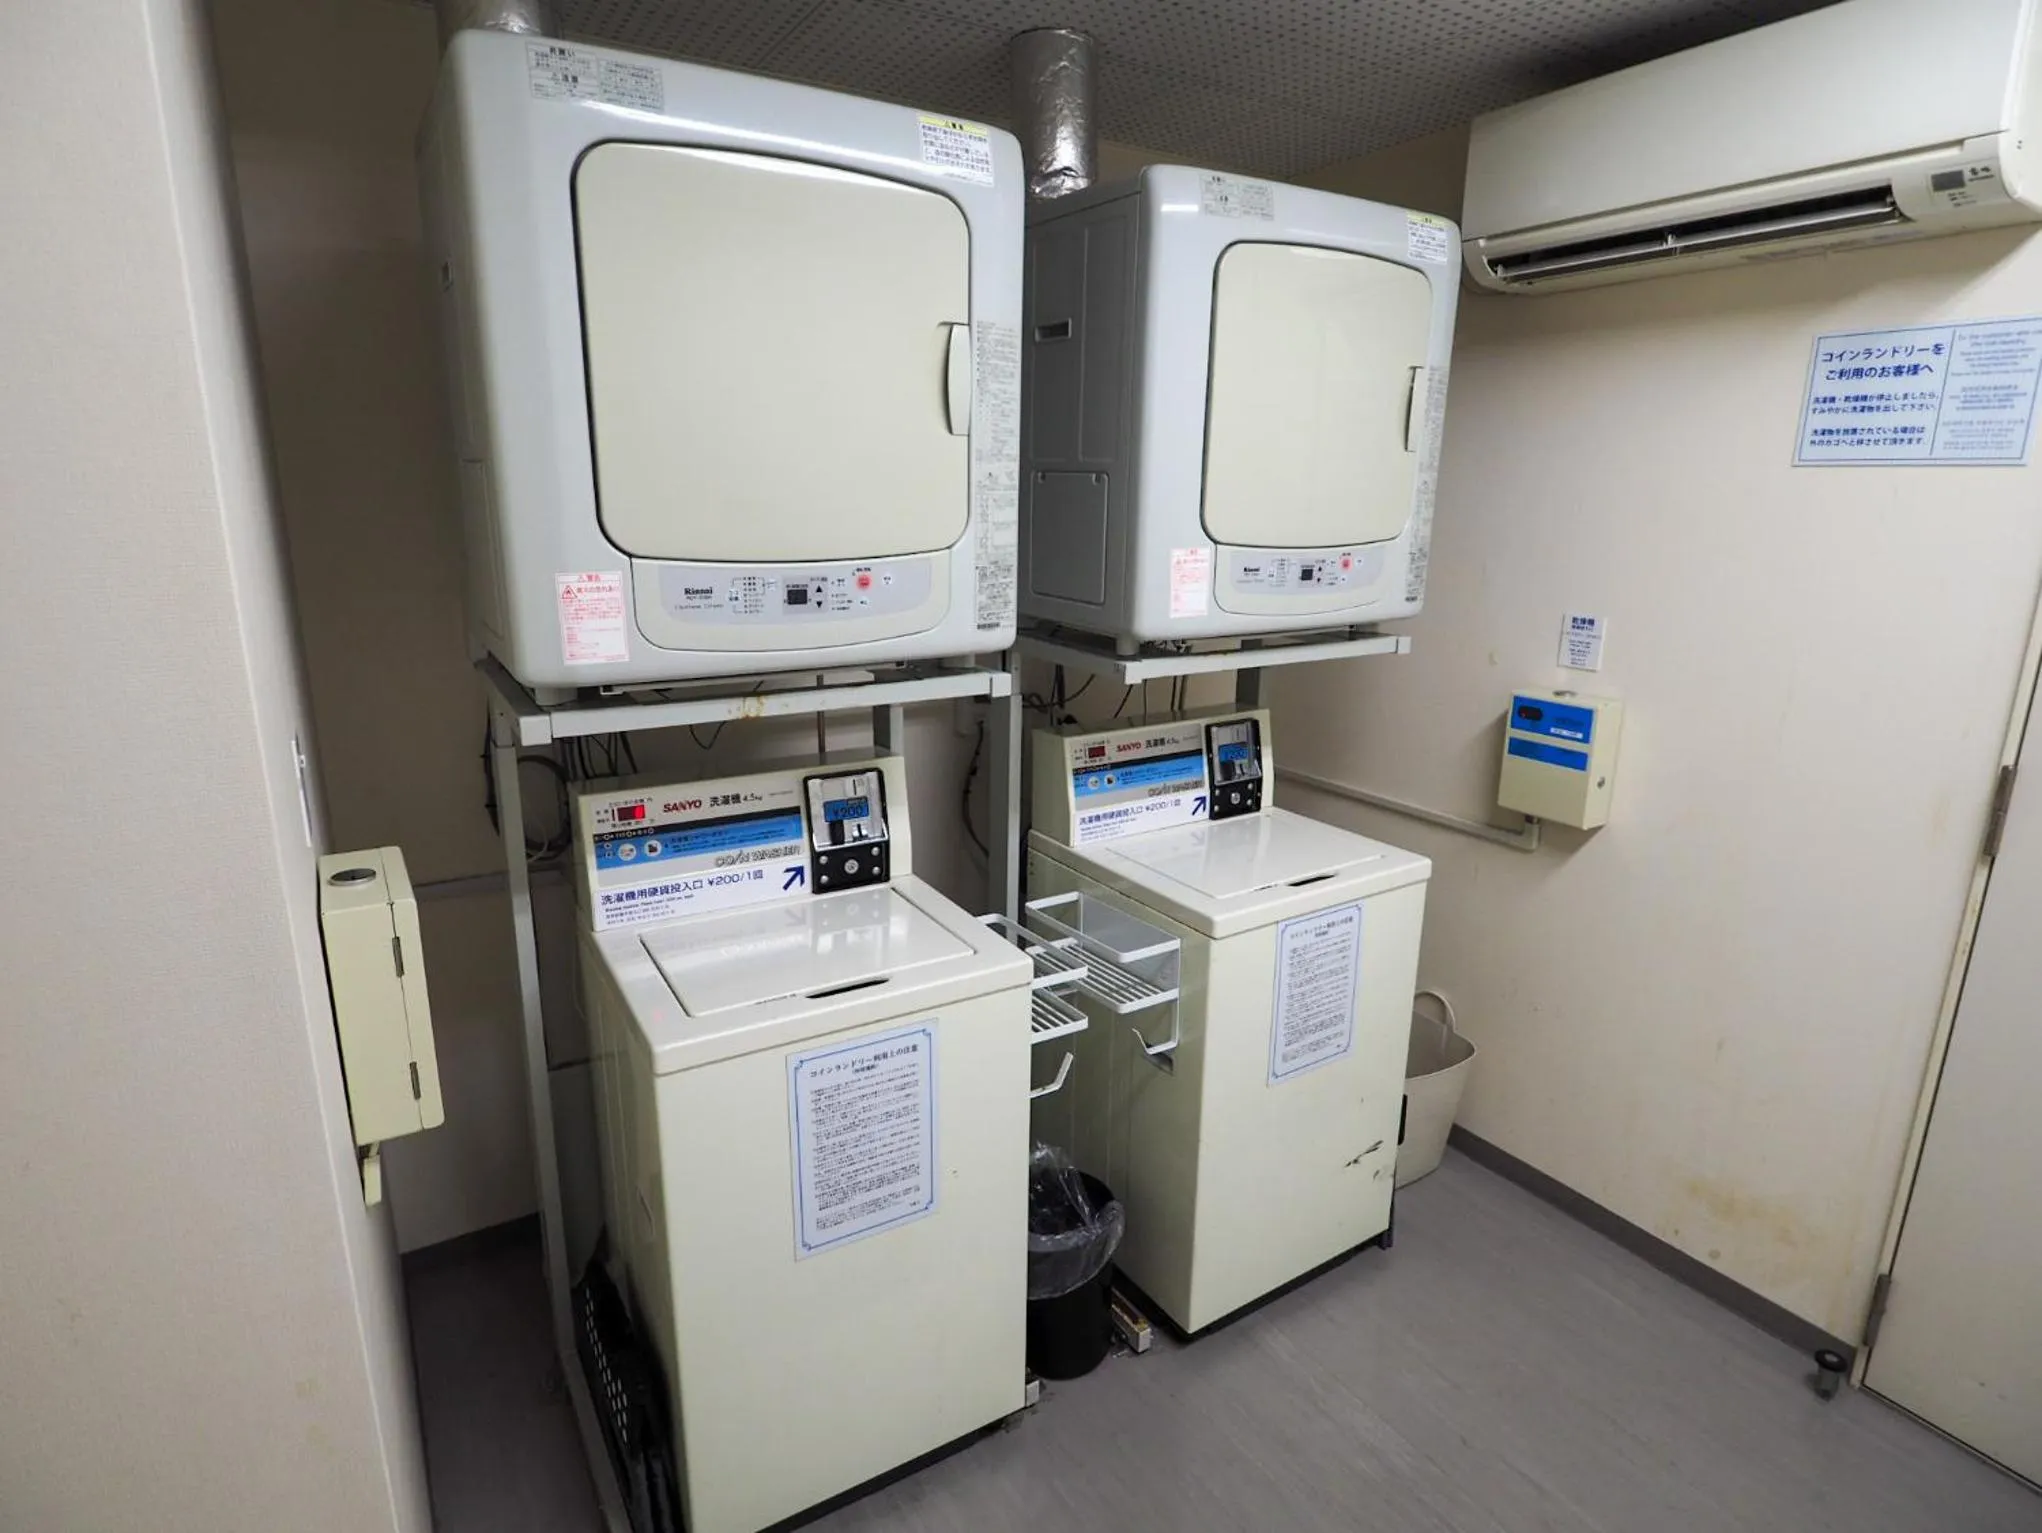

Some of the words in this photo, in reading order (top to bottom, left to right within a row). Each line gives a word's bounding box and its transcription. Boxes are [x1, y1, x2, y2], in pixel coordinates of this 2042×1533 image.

[1821, 343, 1946, 363] コインランドリーを
[1825, 363, 1934, 381] ご利用のお客様へ
[684, 587, 712, 595] Rinnai
[1116, 742, 1142, 752] SANYO
[663, 799, 702, 813] SANYO
[709, 793, 742, 807] 洗濯機
[601, 880, 704, 906] 洗濯機用硬貨投入口
[707, 869, 764, 887] ¥200/1回
